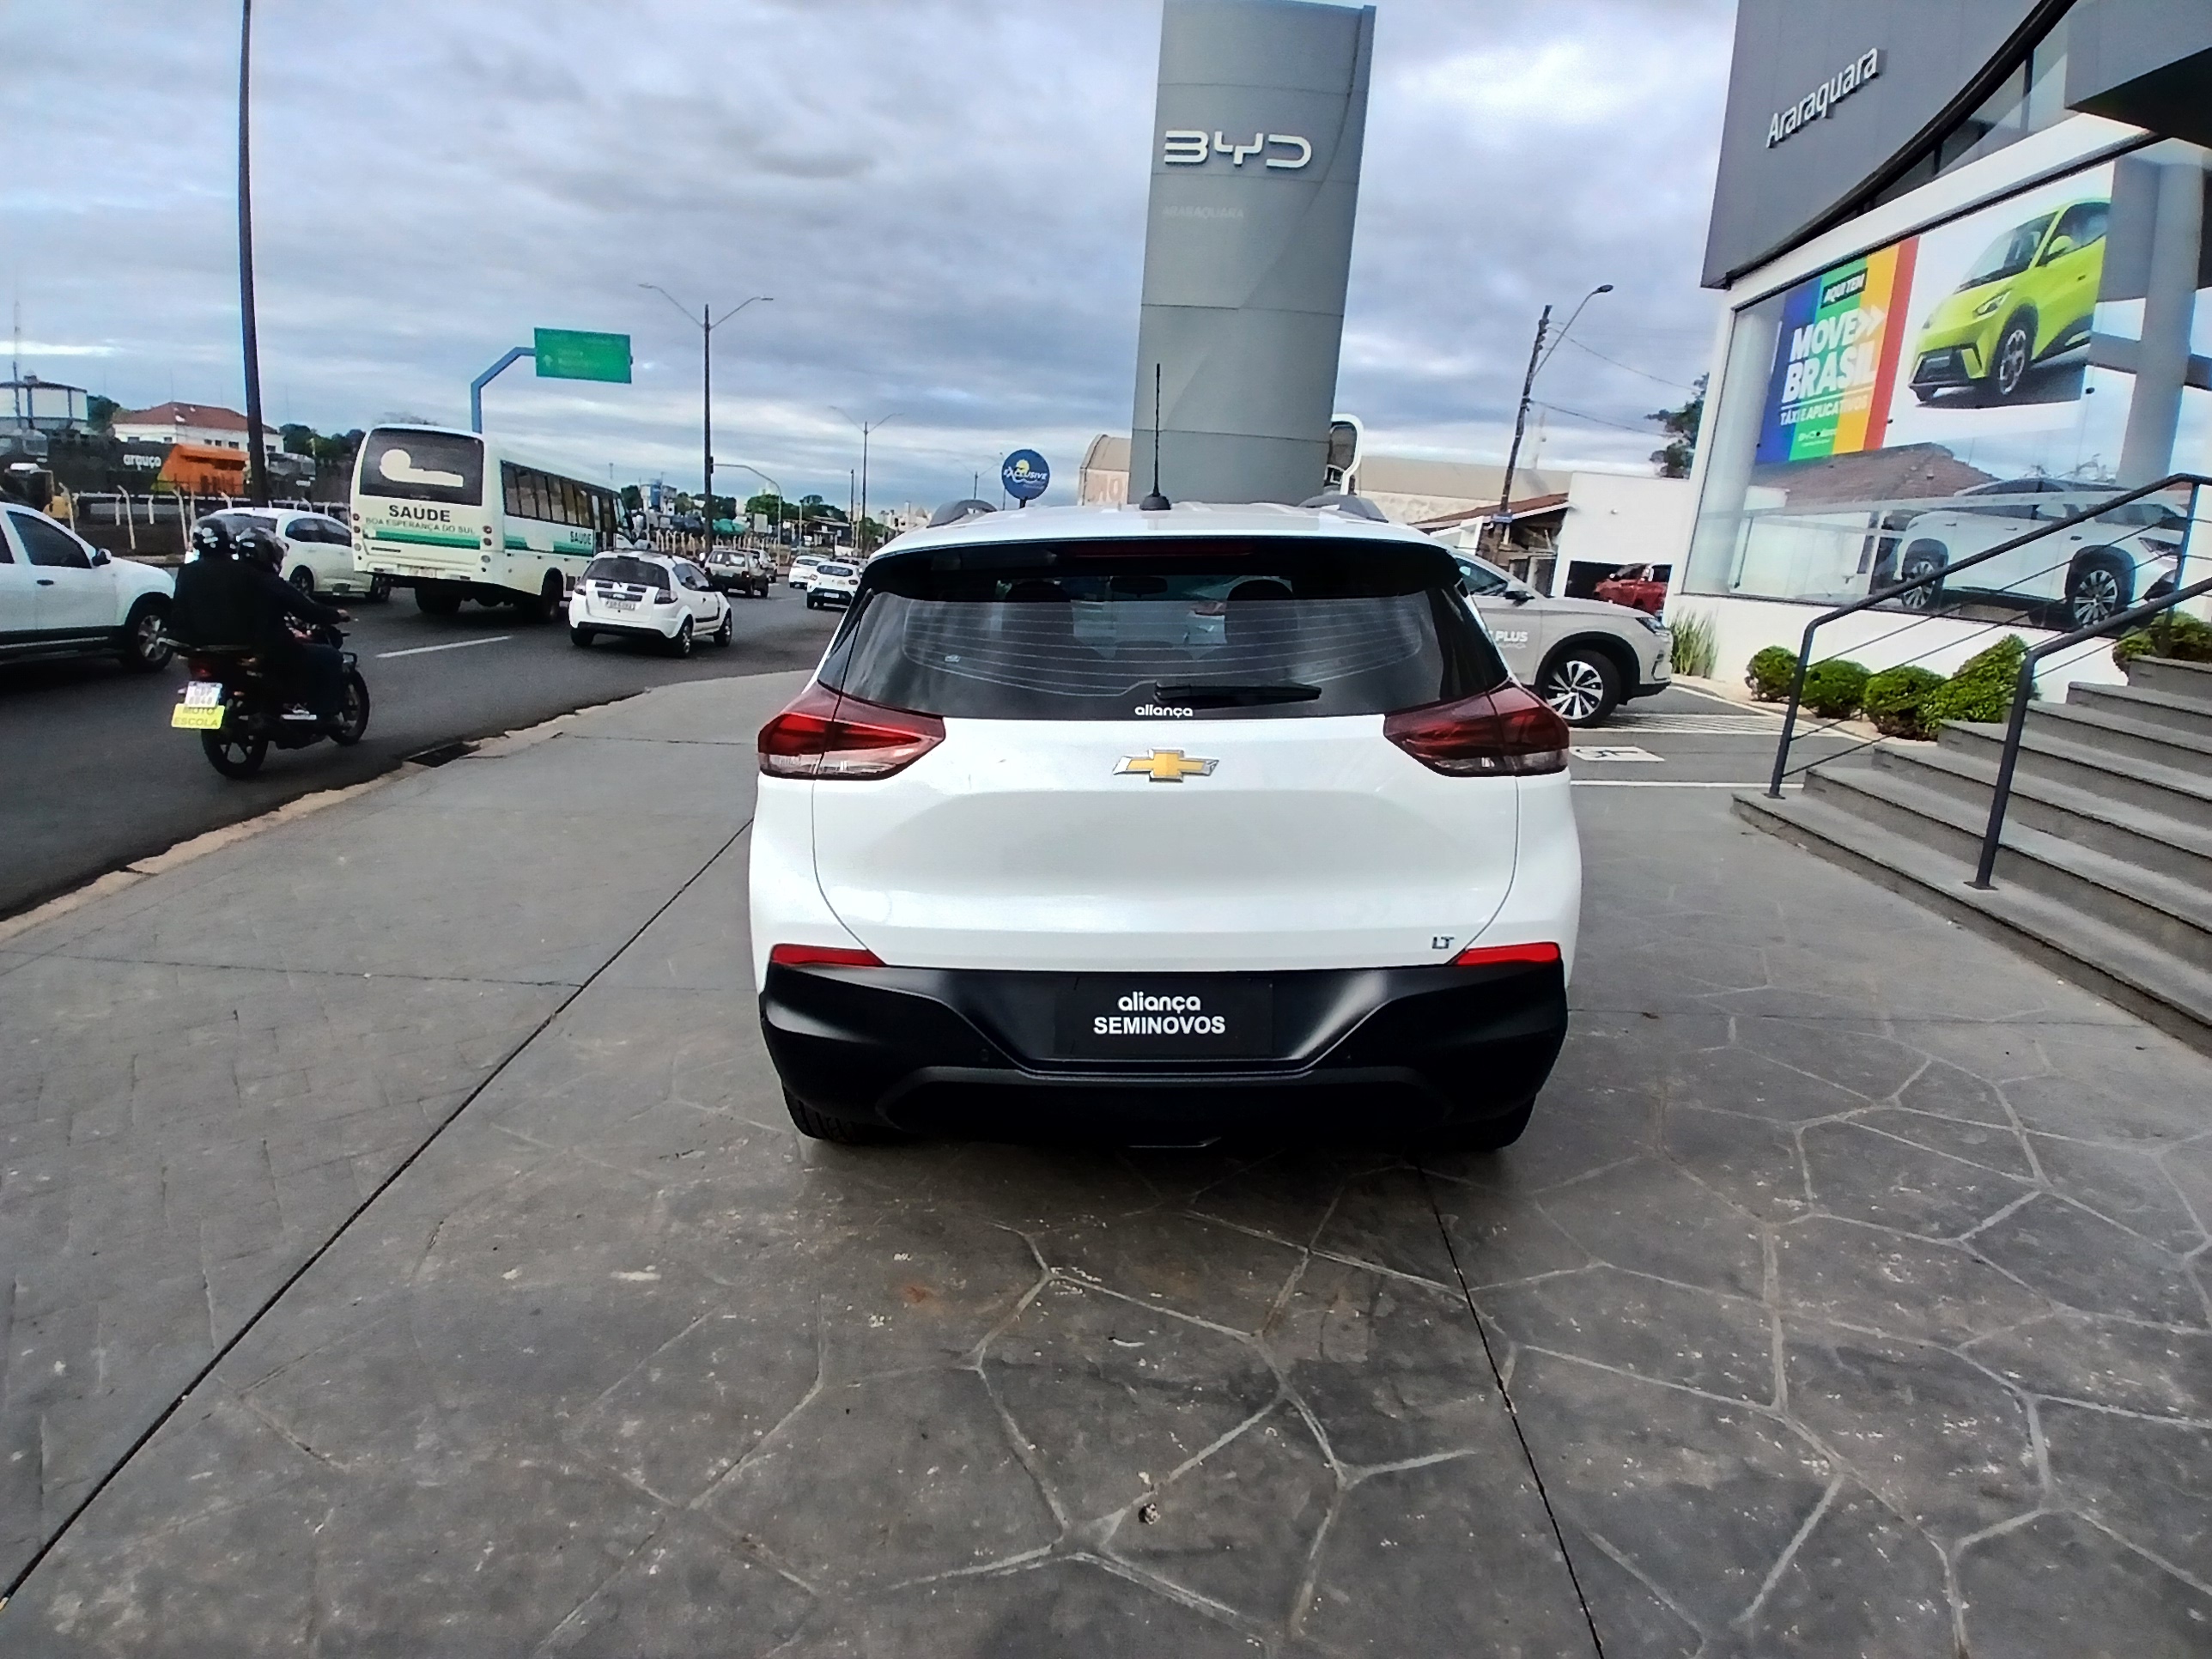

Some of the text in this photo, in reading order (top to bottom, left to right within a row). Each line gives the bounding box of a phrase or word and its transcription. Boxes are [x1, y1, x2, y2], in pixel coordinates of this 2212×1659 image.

[1765, 47, 1878, 149] Araraquara
[1164, 131, 1311, 168] BYD
[1790, 307, 1862, 362] MOVE
[1781, 341, 1877, 404] BRASIL
[389, 503, 451, 523] SAÚDE
[386, 519, 441, 532] ESPERANÇA
[1495, 629, 1528, 642] PLUS
[1134, 704, 1194, 719] aliança
[173, 717, 218, 727] ESCOLA
[1431, 936, 1455, 950] LT
[1118, 991, 1201, 1014] aliança
[1093, 1016, 1226, 1035] SEMINOVOS
